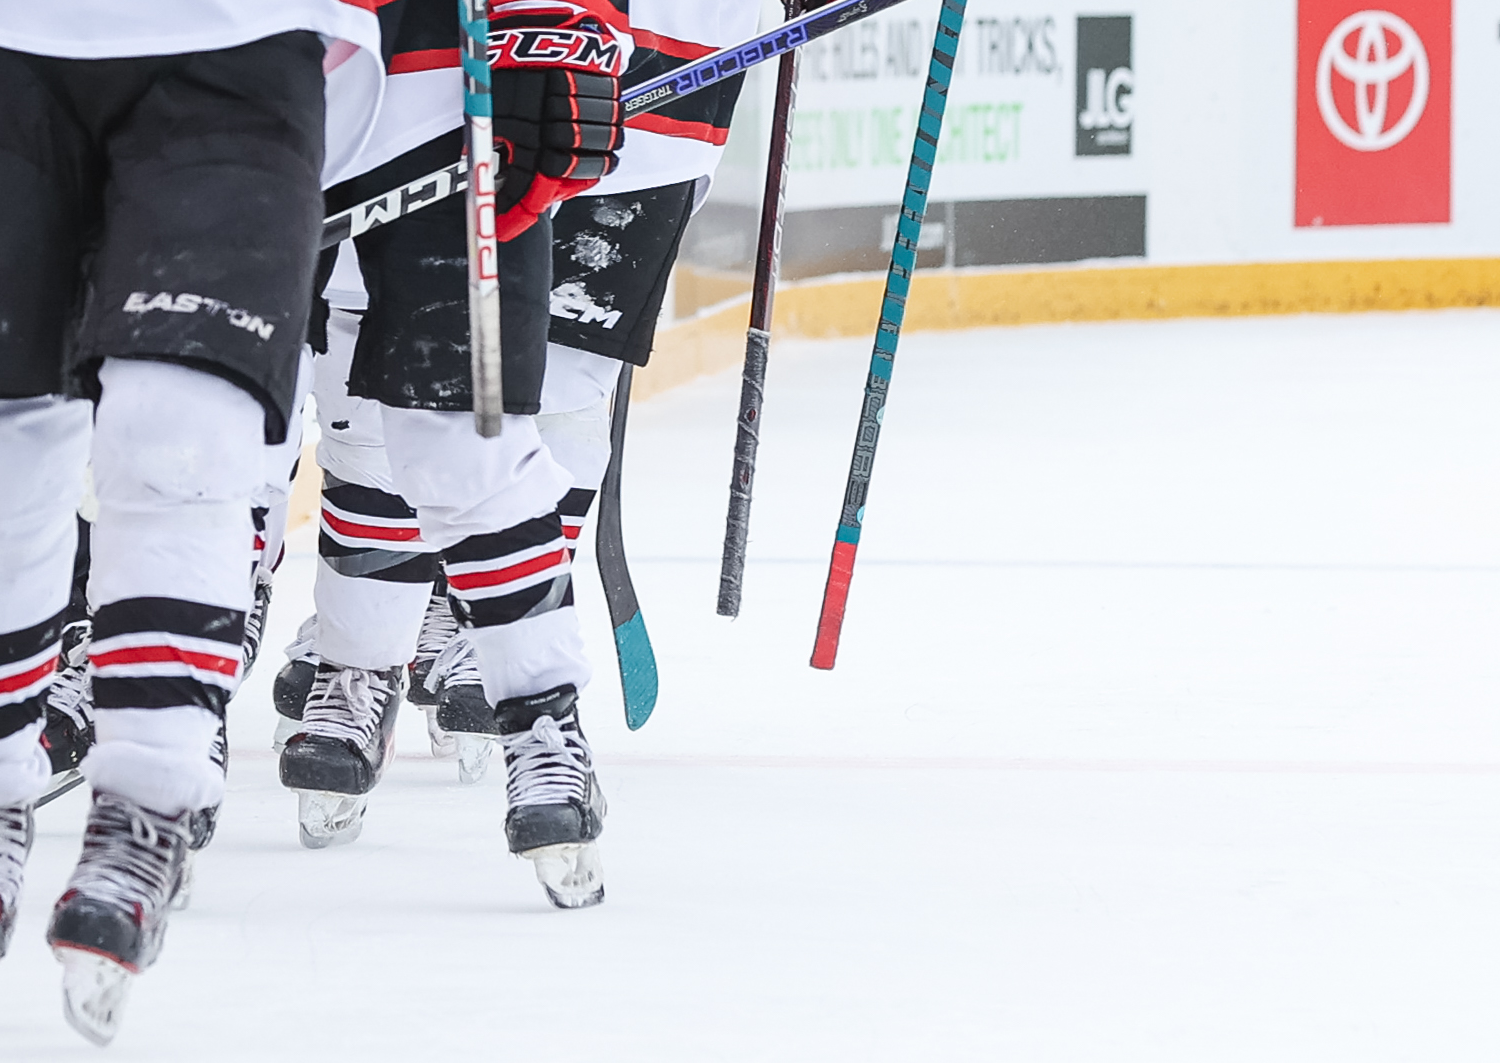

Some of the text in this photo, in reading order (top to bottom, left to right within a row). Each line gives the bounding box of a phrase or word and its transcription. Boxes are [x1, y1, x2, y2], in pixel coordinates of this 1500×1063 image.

[676, 20, 808, 96] RIBCOR
[624, 84, 673, 112] TRIGGER
[122, 291, 275, 342] EASTON
